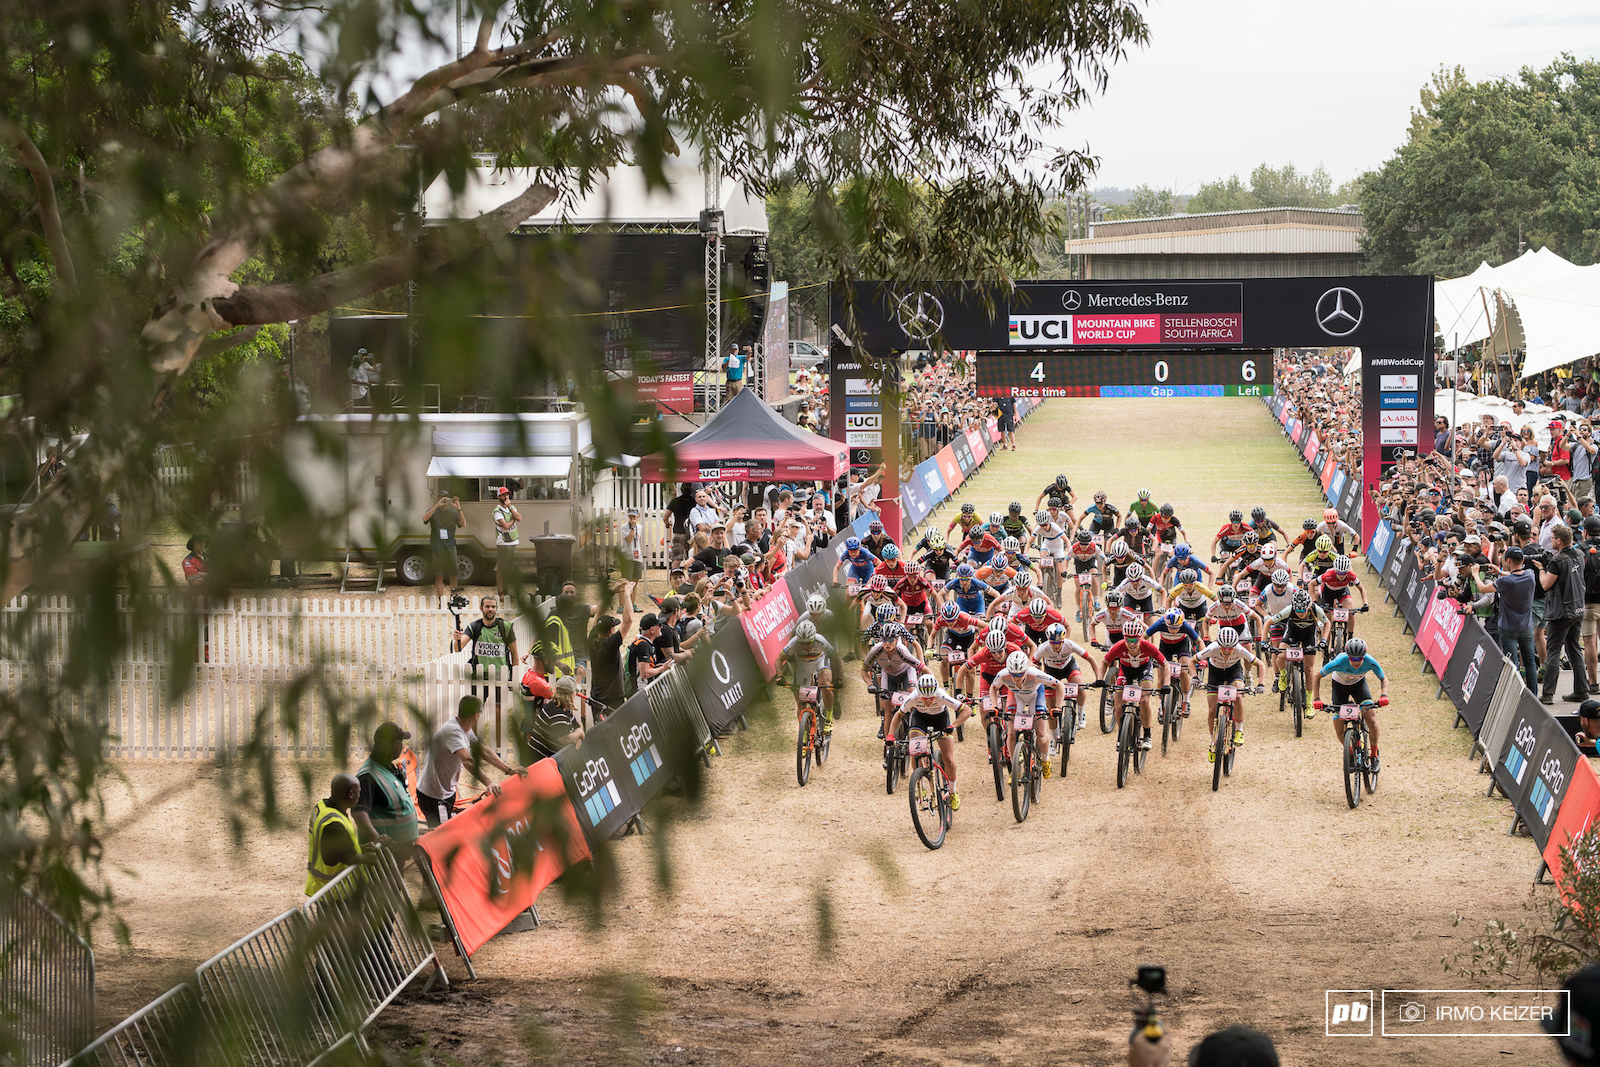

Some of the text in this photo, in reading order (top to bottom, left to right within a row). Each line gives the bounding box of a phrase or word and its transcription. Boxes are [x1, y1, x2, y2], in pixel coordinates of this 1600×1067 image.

[1087, 293, 1189, 307] Mercedes-Benz
[1077, 318, 1156, 329] MOUNTAIN BIKE
[1164, 317, 1238, 328] STELLENBOSCH
[1020, 320, 1068, 339] UCI
[1077, 330, 1136, 340] WORLD CUP
[1165, 328, 1233, 339] SOUTH AFRICA
[1371, 358, 1424, 368] #MBWorldCup
[1030, 362, 1046, 382] 4
[1154, 361, 1169, 382] 0
[1241, 360, 1256, 381] 6
[637, 374, 690, 384] TODAY'S FASTEST
[1011, 387, 1066, 397] Race time
[1151, 387, 1174, 398] Gap
[1238, 386, 1260, 396] Left
[854, 416, 878, 427] UCI
[478, 649, 501, 657] RADIO
[721, 681, 744, 710] OAKLEY
[1224, 689, 1230, 697] 4
[1021, 718, 1026, 726] 5
[620, 722, 652, 759] GoPro
[1514, 716, 1536, 757] GoPro
[915, 741, 922, 750] 2
[573, 756, 610, 797] GoPro
[1540, 748, 1565, 795] GoPro
